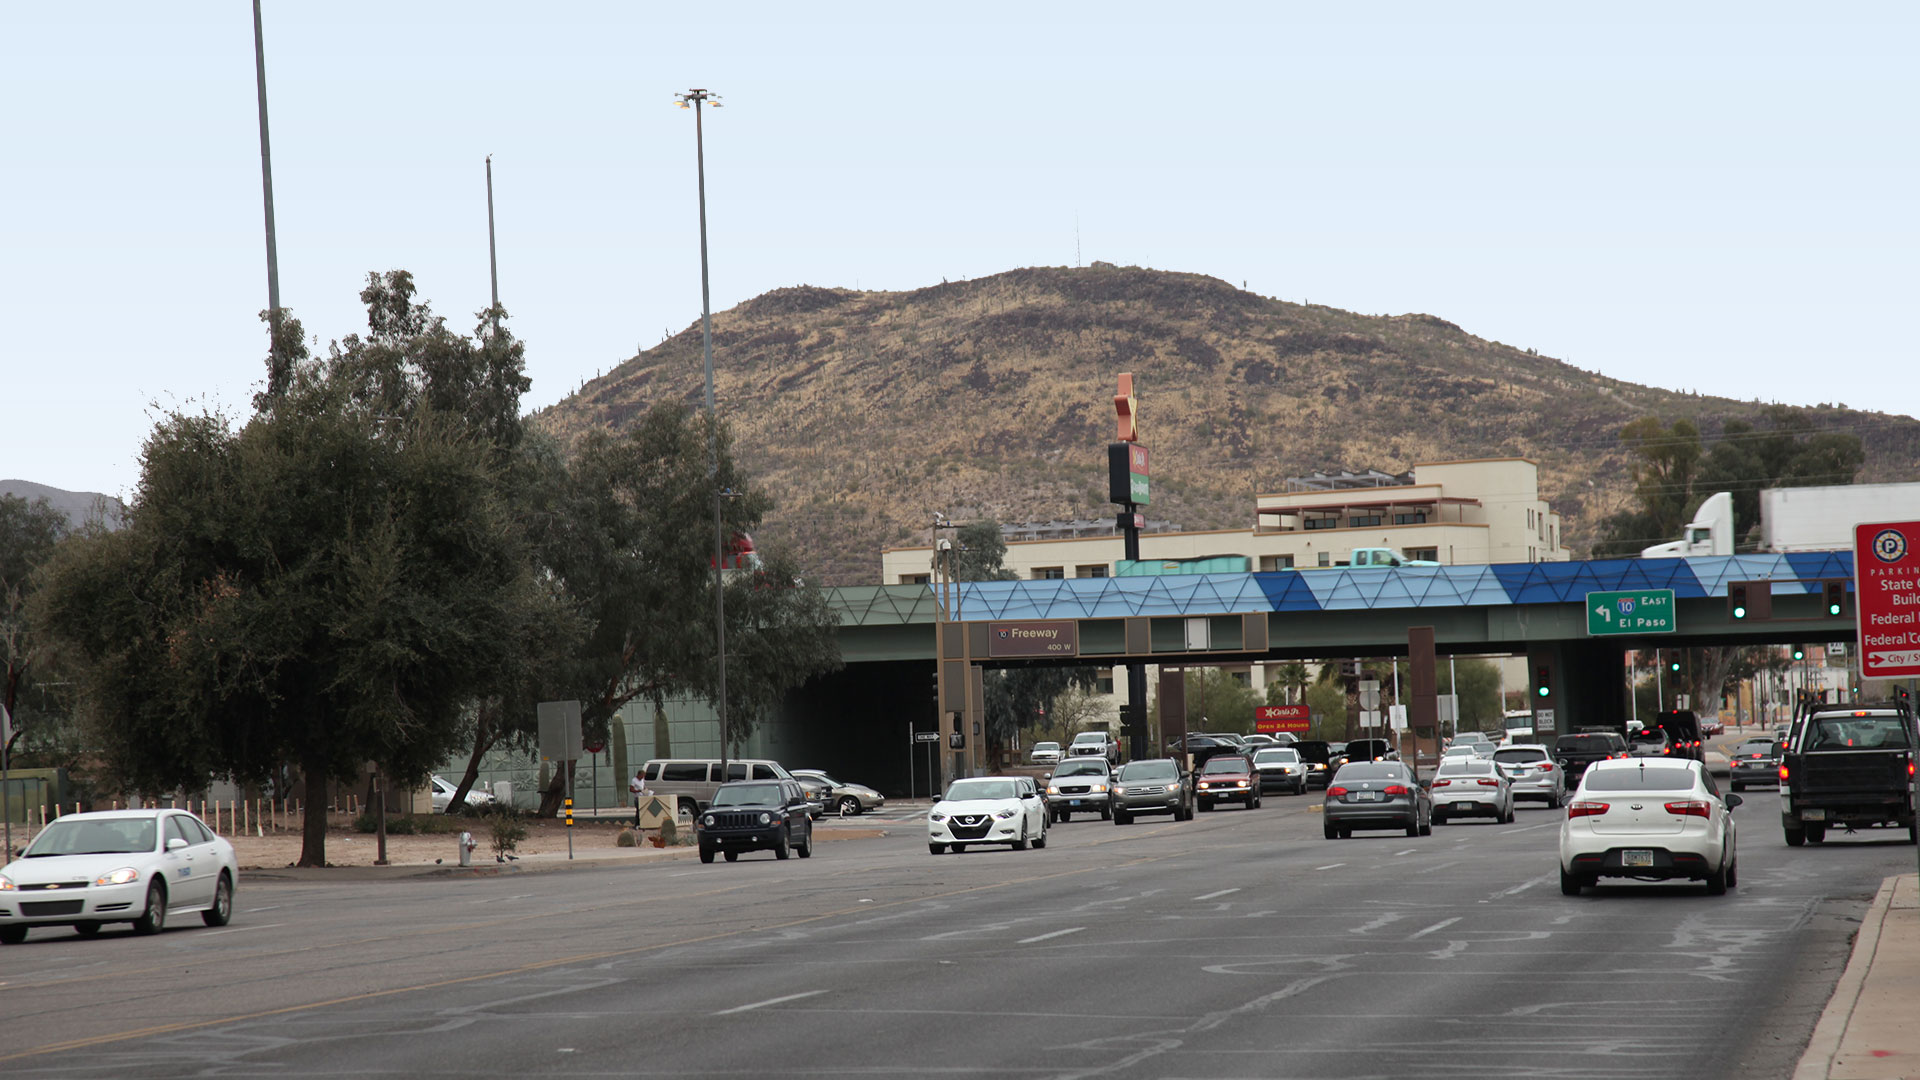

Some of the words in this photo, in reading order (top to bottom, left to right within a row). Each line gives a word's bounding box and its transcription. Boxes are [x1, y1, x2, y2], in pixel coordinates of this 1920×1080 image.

[1885, 540, 1896, 553] P
[1881, 579, 1914, 591] State
[1621, 601, 1633, 612] 10
[1619, 618, 1631, 628] El
[1637, 617, 1666, 627] Paso
[1871, 611, 1915, 625] Federal
[1011, 628, 1058, 639] Freeway
[1865, 632, 1906, 646] Federal
[1047, 643, 1062, 651] 400
[1887, 654, 1905, 665] City
